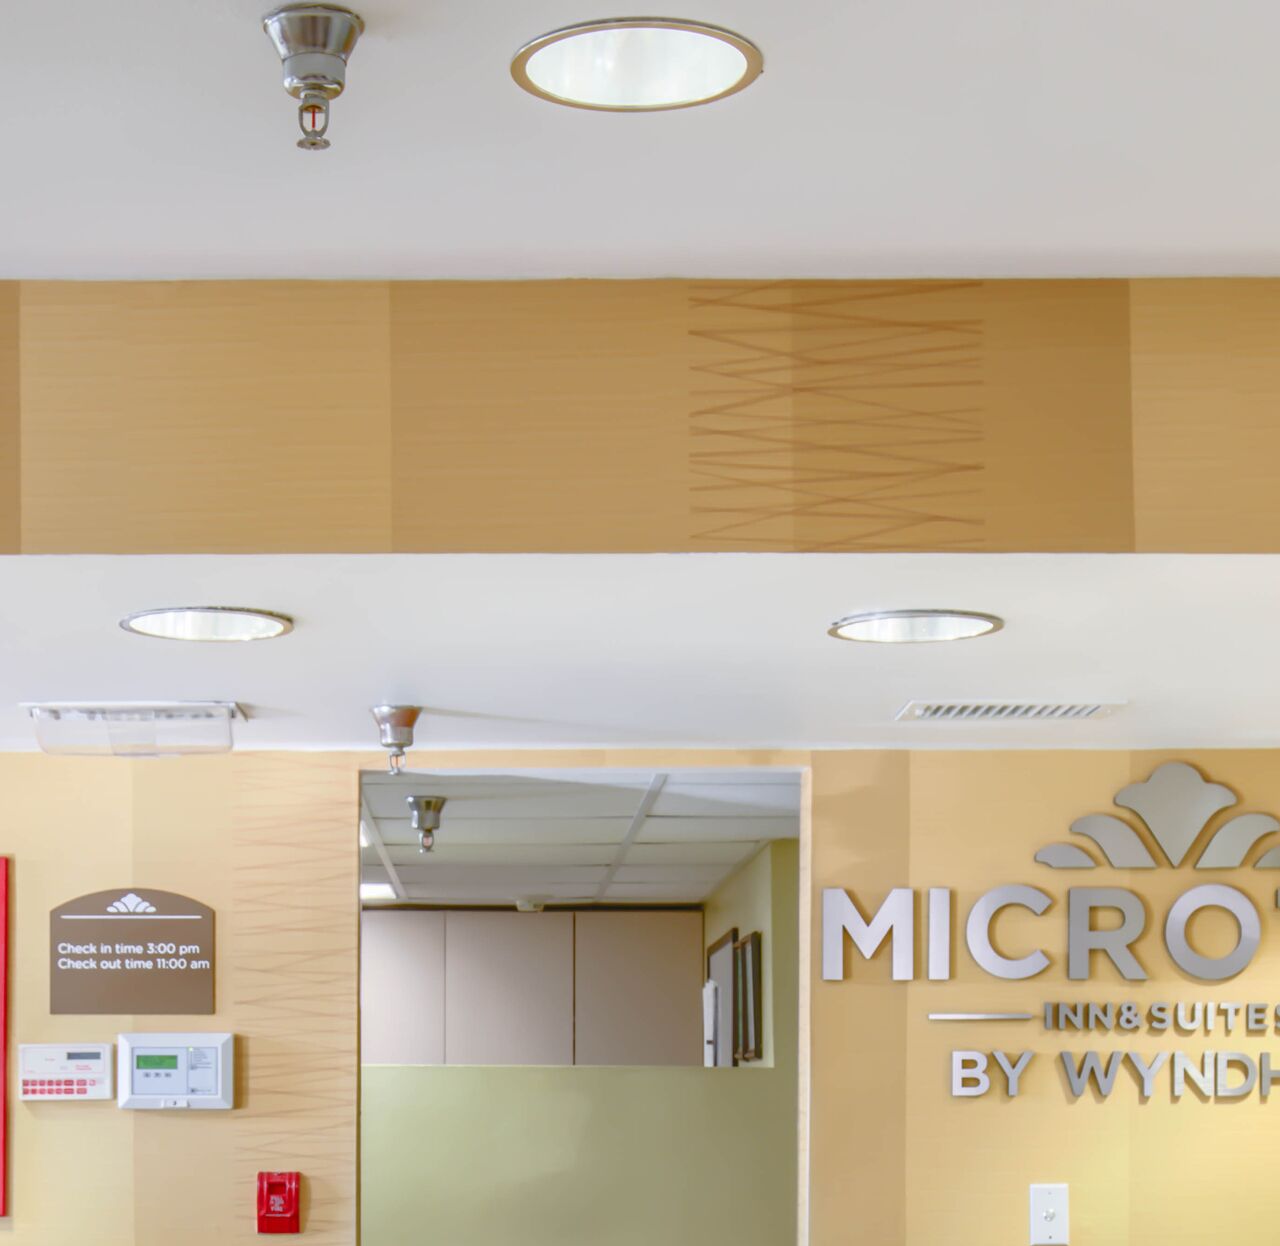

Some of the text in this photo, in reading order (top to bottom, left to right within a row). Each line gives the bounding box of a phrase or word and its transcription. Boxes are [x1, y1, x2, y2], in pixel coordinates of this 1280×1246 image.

[58, 943, 200, 957] Check in time 3:00 pm
[58, 958, 210, 970] Check out time 11:00 am
[950, 1051, 1034, 1098] BY
